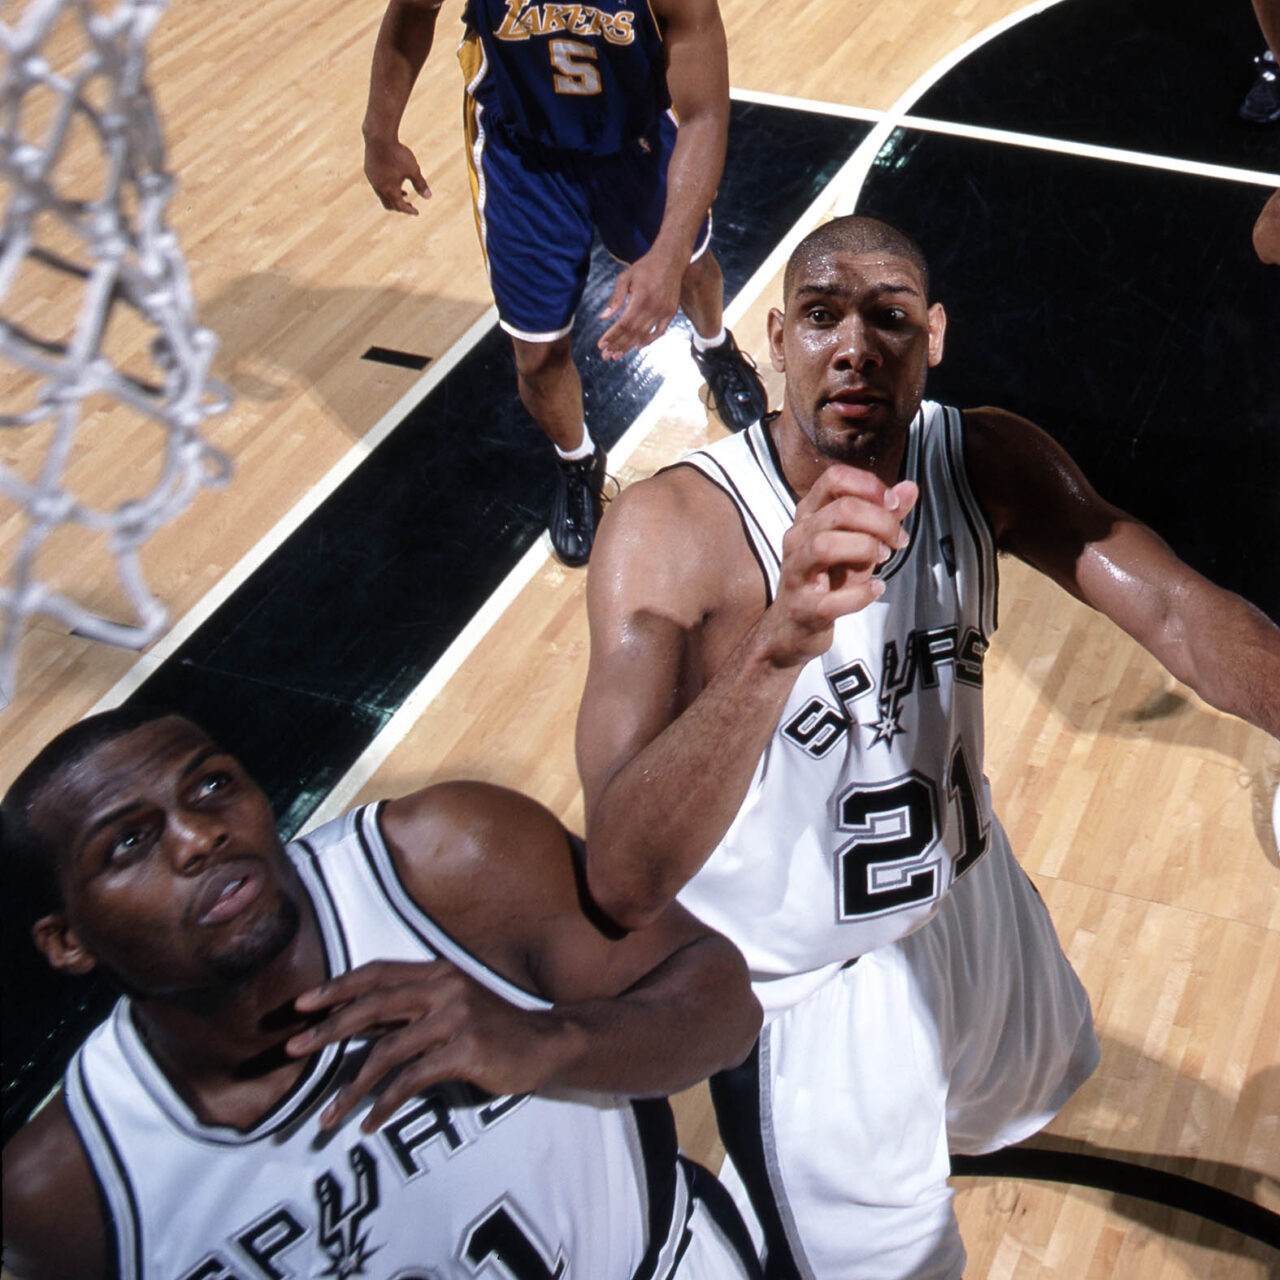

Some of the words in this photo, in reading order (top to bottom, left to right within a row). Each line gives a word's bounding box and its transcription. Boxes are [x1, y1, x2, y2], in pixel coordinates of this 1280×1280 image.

[548, 38, 602, 96] 5
[779, 625, 989, 761] SPURS
[833, 735, 991, 925] 21
[172, 1089, 536, 1280] PUR
